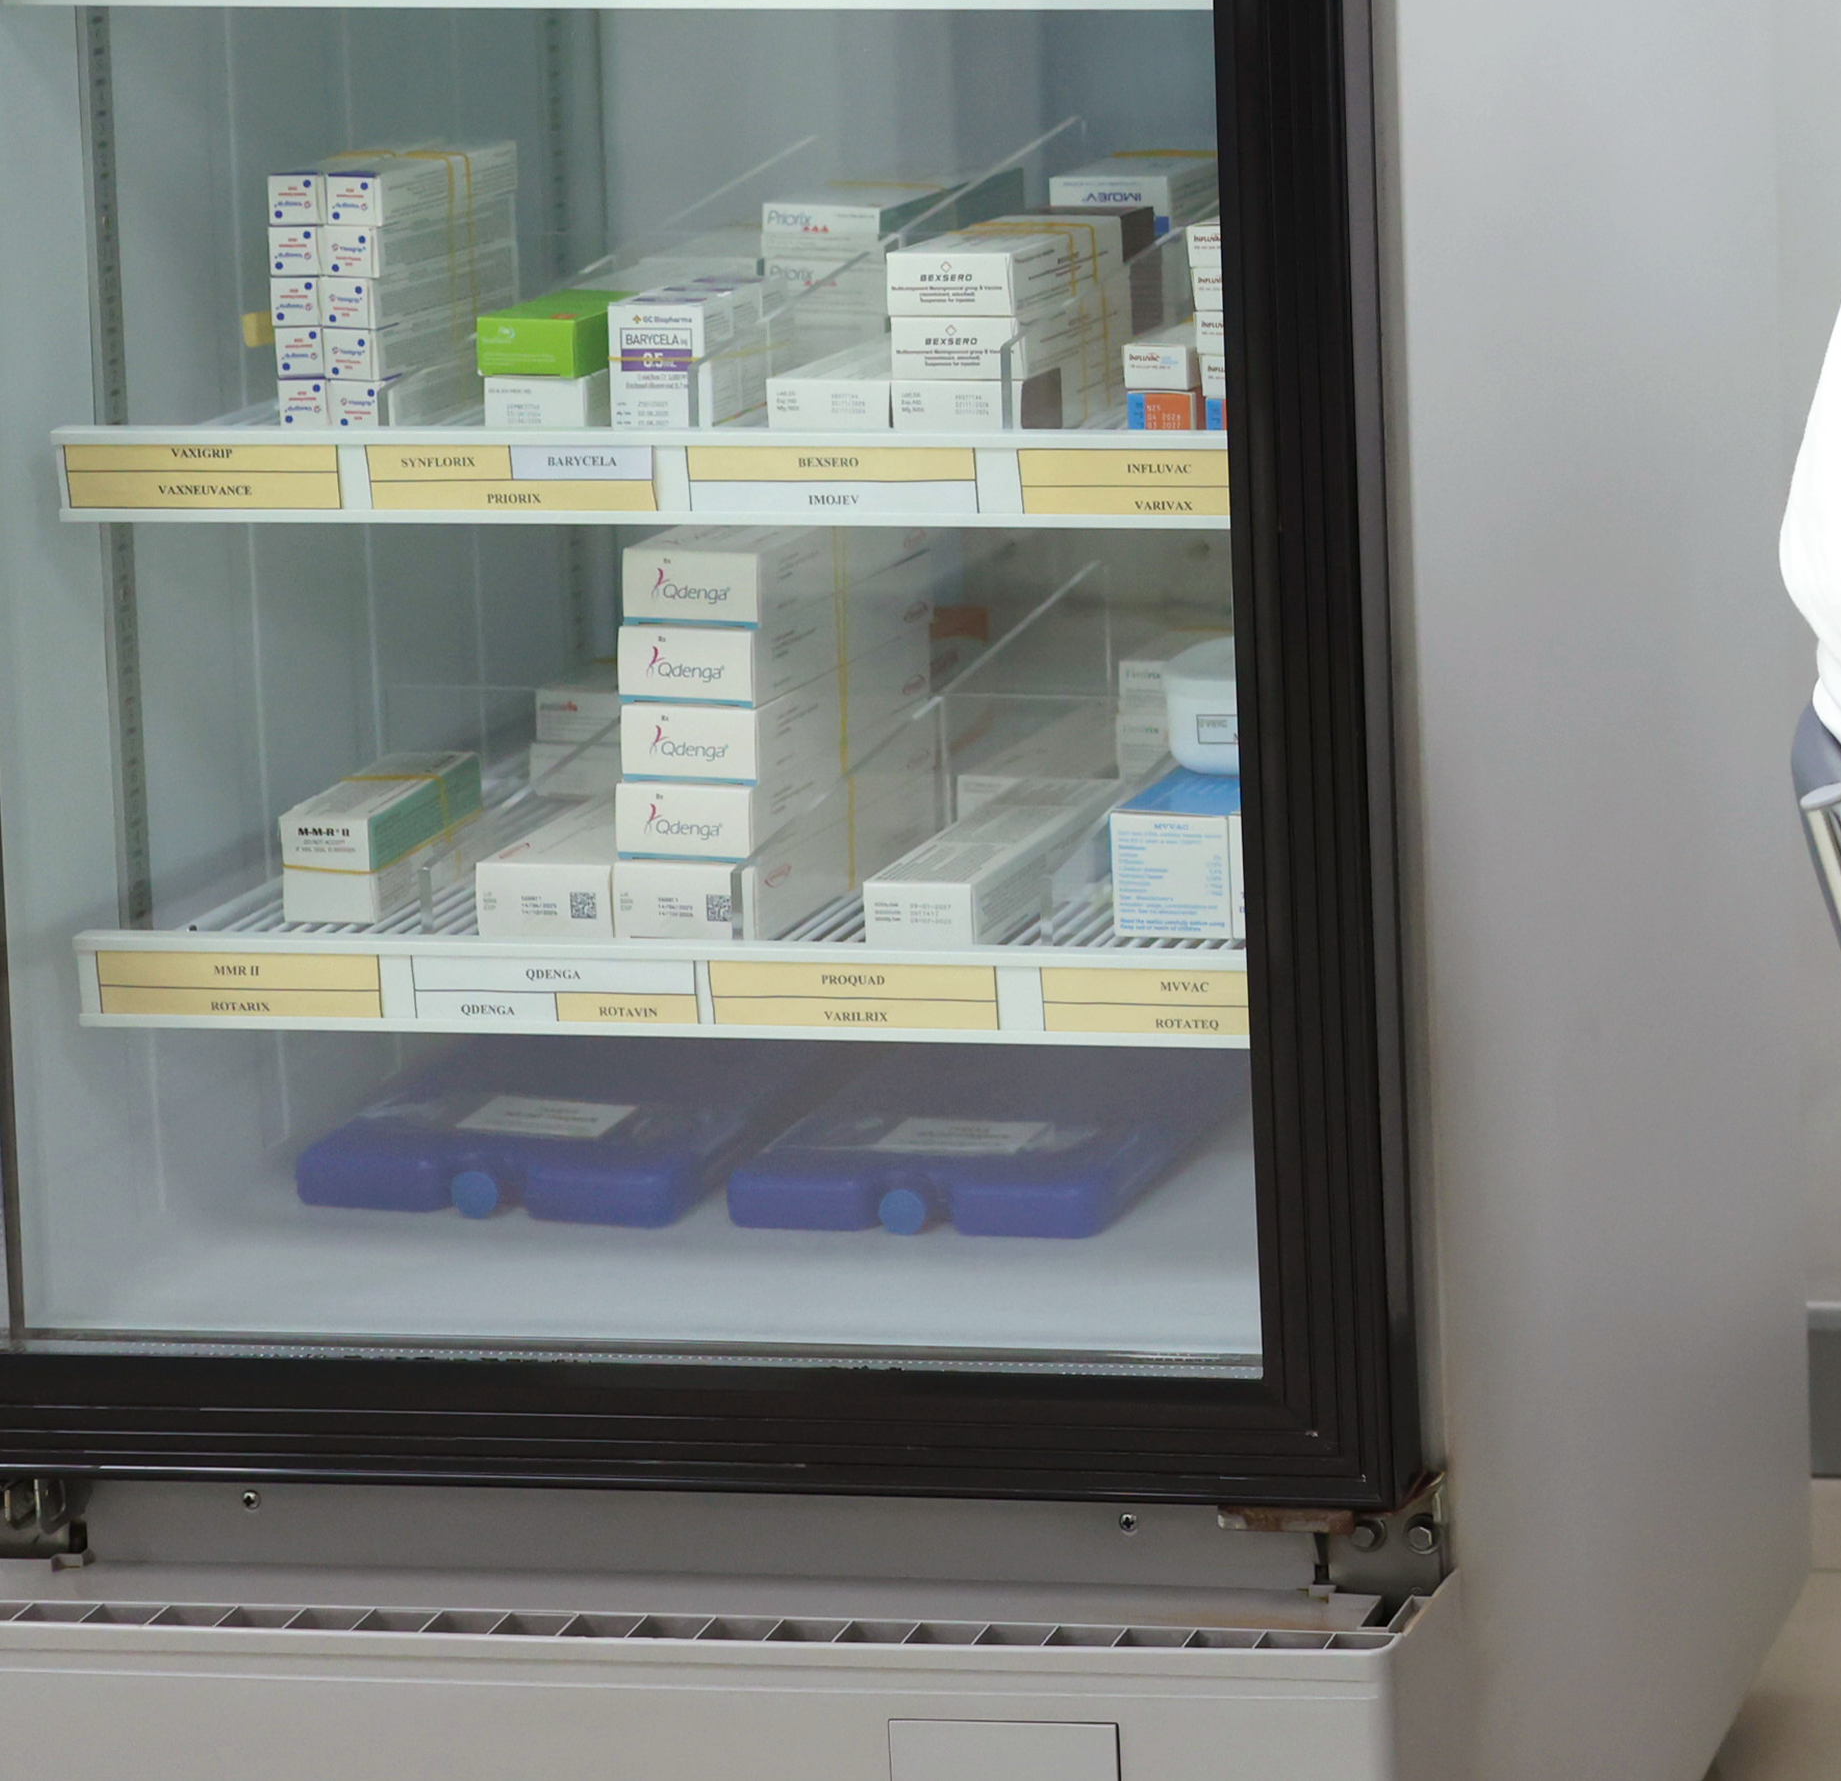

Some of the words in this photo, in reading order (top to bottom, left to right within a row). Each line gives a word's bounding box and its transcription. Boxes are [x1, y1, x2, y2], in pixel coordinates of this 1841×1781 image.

[1086, 191, 1142, 203] IMOJEV
[919, 273, 973, 282] BEXSERO
[625, 333, 680, 346] BARYCELA
[924, 337, 978, 346] BEXSERO
[170, 447, 234, 460] VAXIGRIP
[400, 456, 476, 468] SYNFLORIX
[547, 455, 617, 467] BARYCELA
[798, 457, 860, 468] BEXSERO
[1127, 463, 1192, 474] INFLUVAC
[157, 484, 253, 496] VAXNEUVANCE
[486, 493, 542, 504] PRIORIX
[808, 494, 859, 506] IMOJEV
[1134, 500, 1193, 511] VARIVAX
[213, 964, 247, 976] MMR
[250, 965, 260, 977] II
[525, 968, 581, 982] QDENGA
[821, 974, 886, 987] PROQUAD
[1160, 981, 1210, 993] MVVAC
[210, 1001, 271, 1012] ROTARIX
[460, 1004, 515, 1017] QDENGA
[598, 1006, 658, 1018] ROTAVIN
[823, 1010, 888, 1022] VARILRIX
[1155, 1018, 1220, 1032] ROTATEQ
